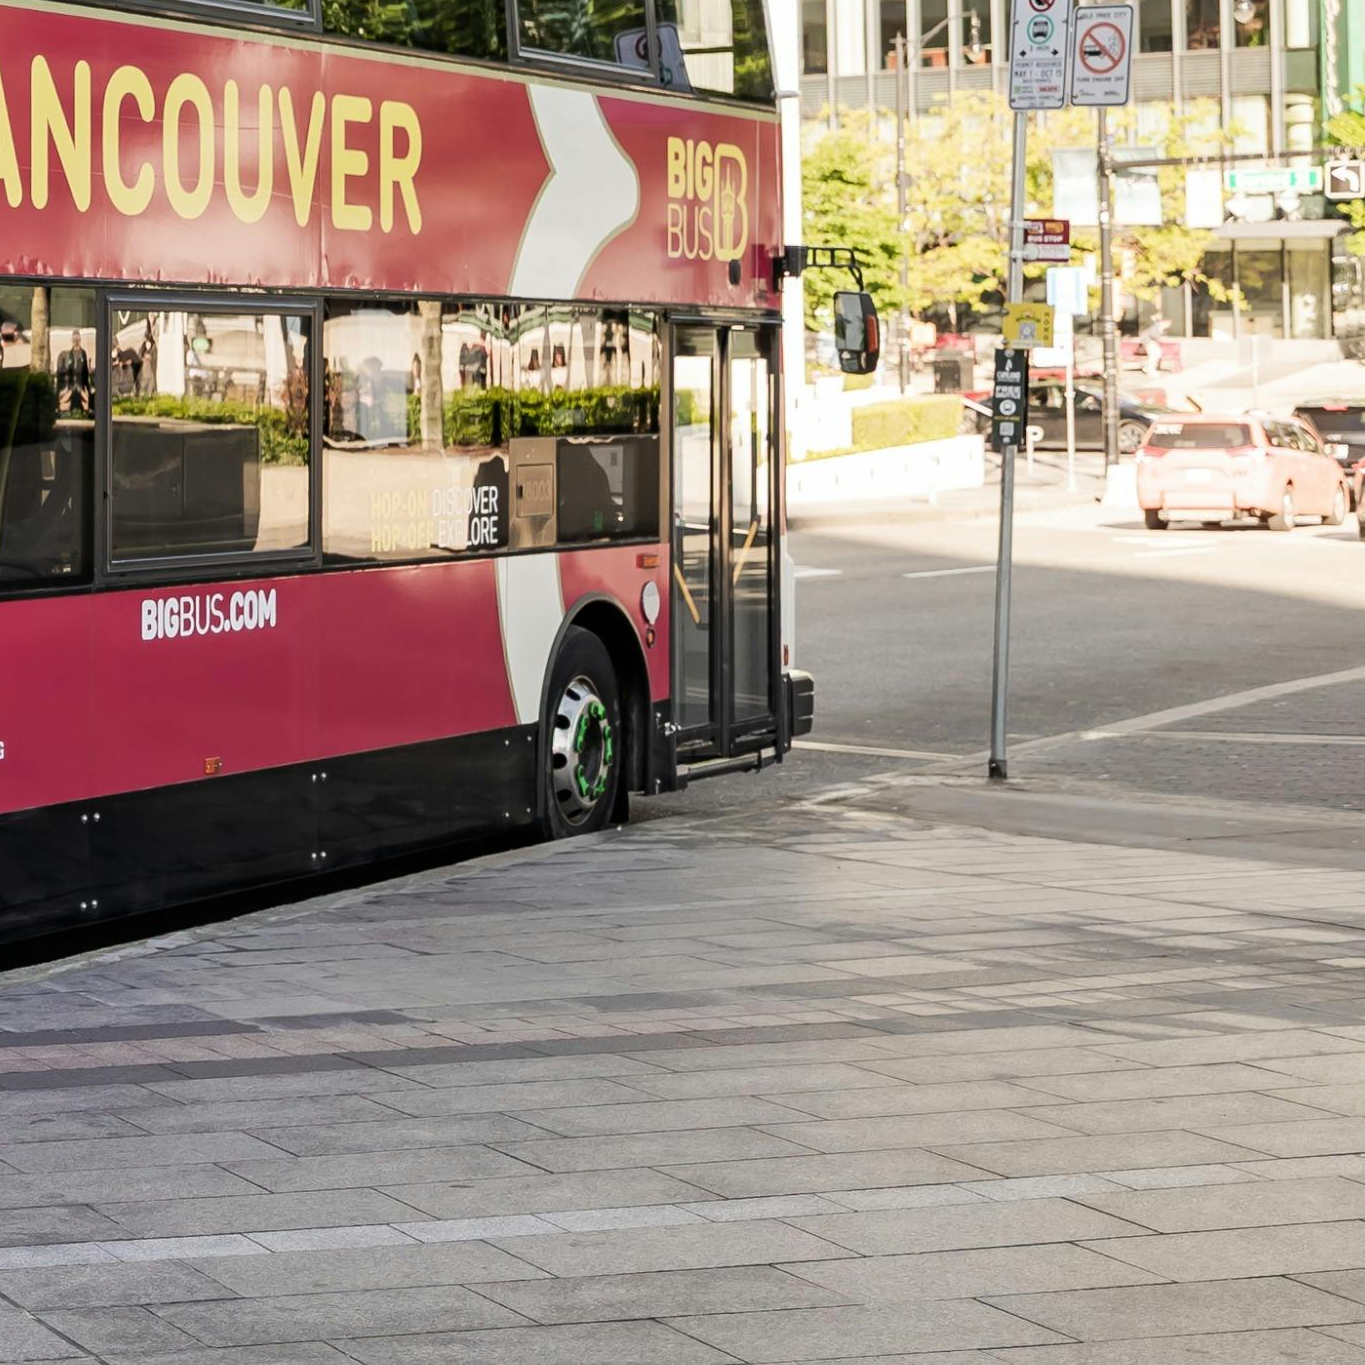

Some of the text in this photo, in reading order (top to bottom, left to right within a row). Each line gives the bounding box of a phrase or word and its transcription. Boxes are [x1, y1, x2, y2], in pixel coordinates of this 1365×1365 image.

[667, 136, 713, 202] BIG
[667, 203, 713, 260] BUS
[432, 485, 498, 516] DISCOVER
[438, 516, 499, 547] EXPLORE
[141, 588, 277, 641] BIGBUS.COM
